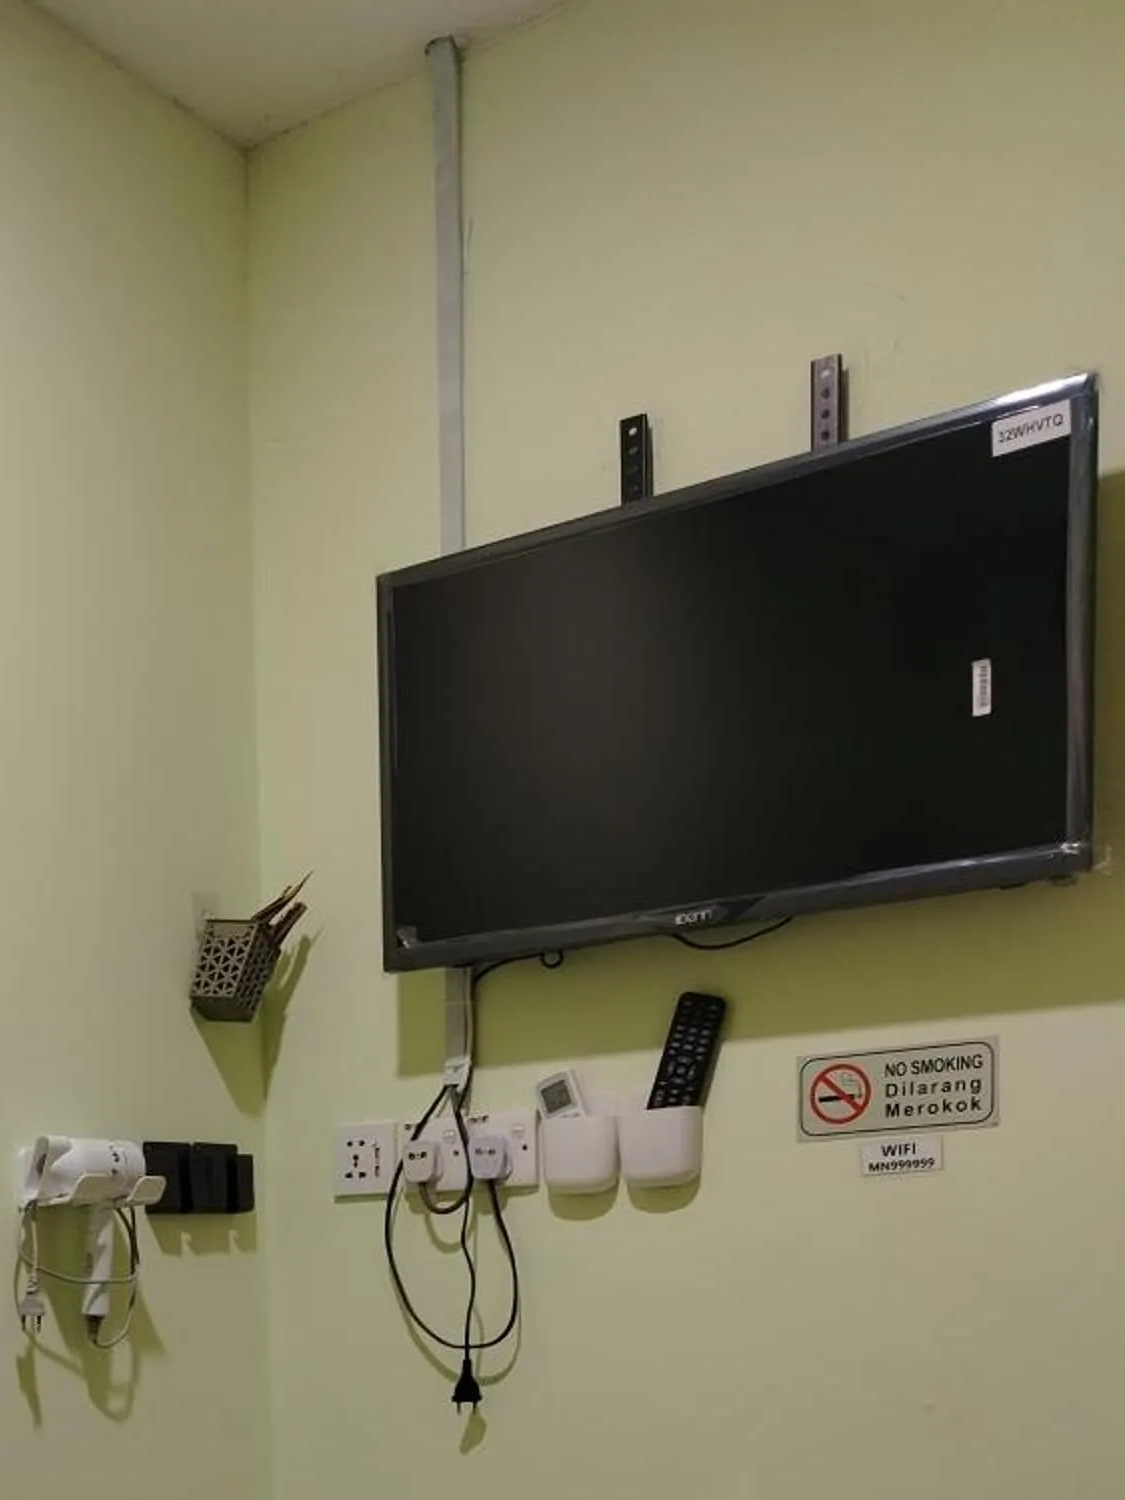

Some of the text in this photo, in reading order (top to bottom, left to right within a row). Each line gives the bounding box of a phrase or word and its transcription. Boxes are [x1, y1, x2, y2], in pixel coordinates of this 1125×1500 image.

[885, 1053, 984, 1077] NO SMOKING
[885, 1078, 982, 1098] Dilarang
[885, 1096, 982, 1117] Merokok
[881, 1142, 916, 1157] WIFI
